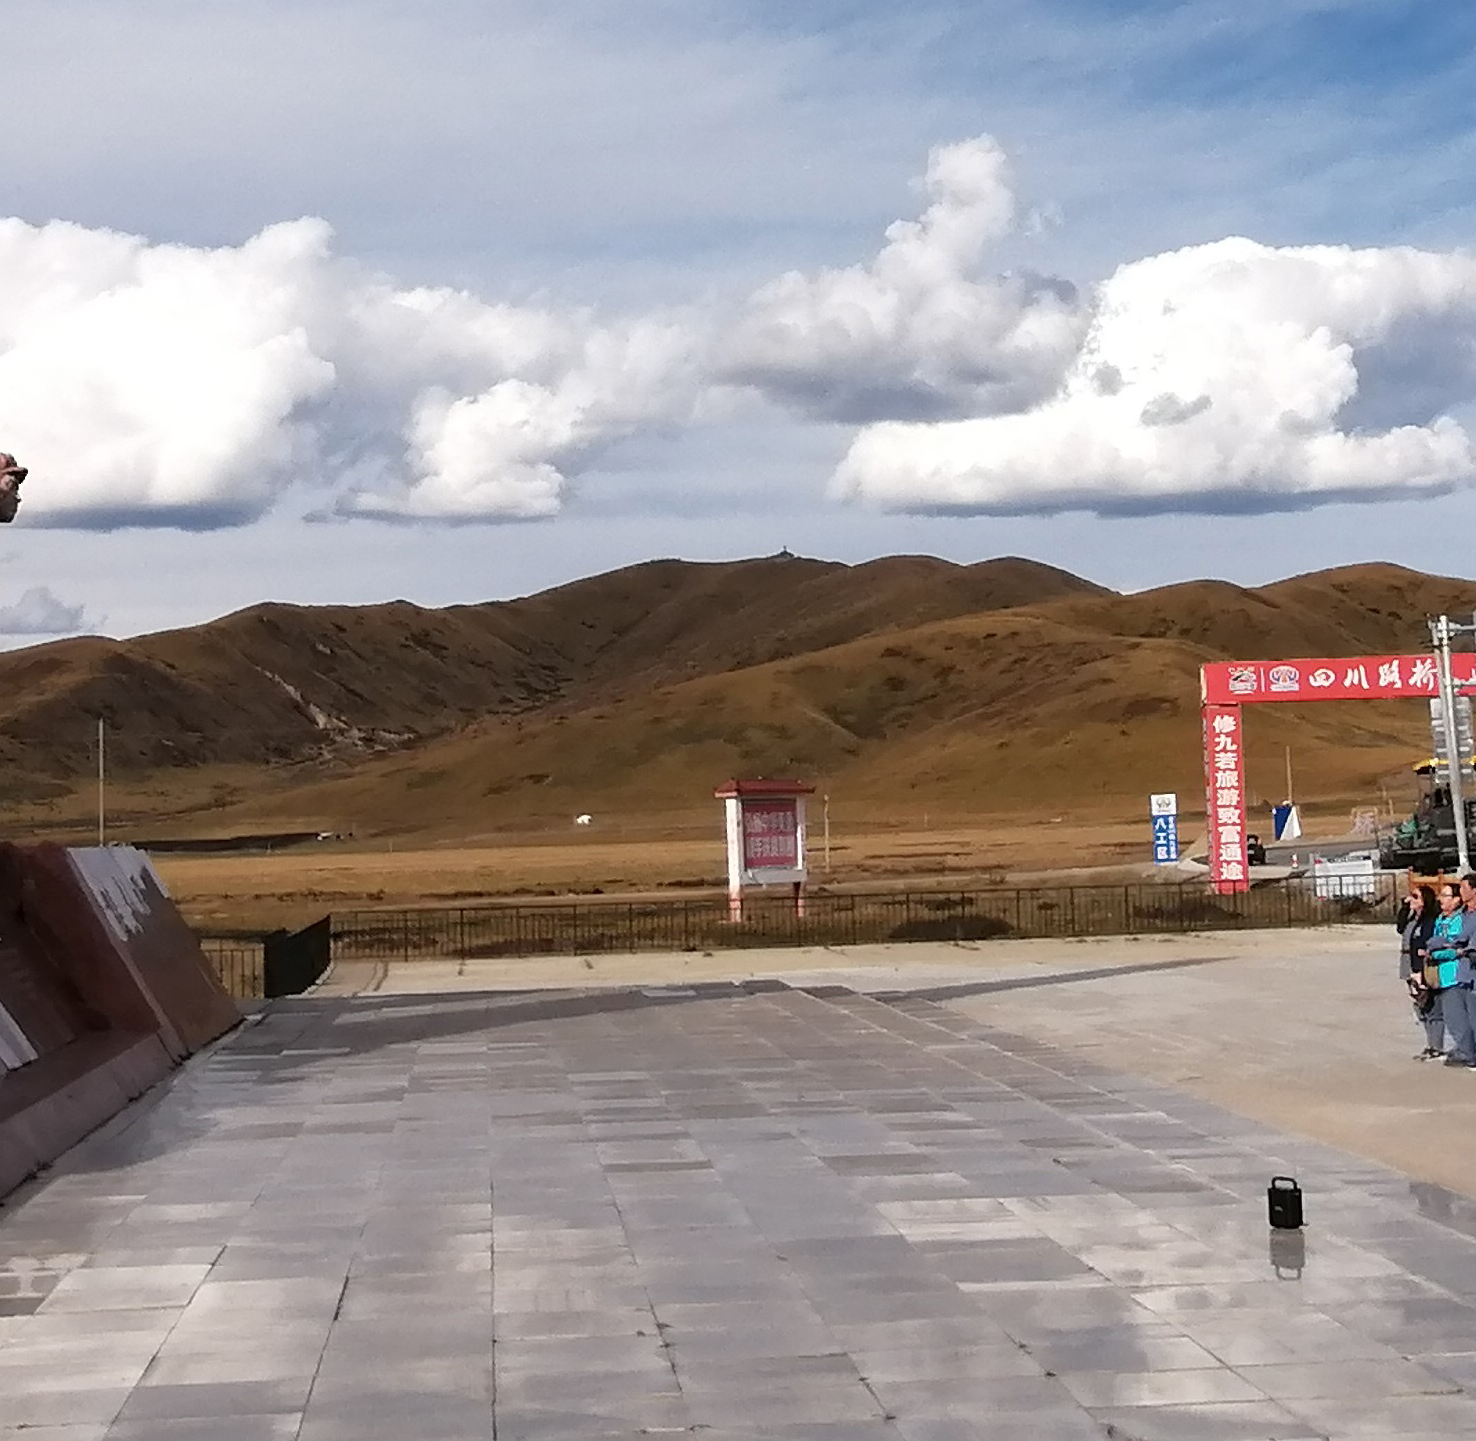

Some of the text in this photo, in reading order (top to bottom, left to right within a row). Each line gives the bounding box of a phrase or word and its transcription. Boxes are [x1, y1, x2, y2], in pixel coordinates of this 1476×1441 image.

[1212, 714, 1243, 880] 修九若旅游致富通途
